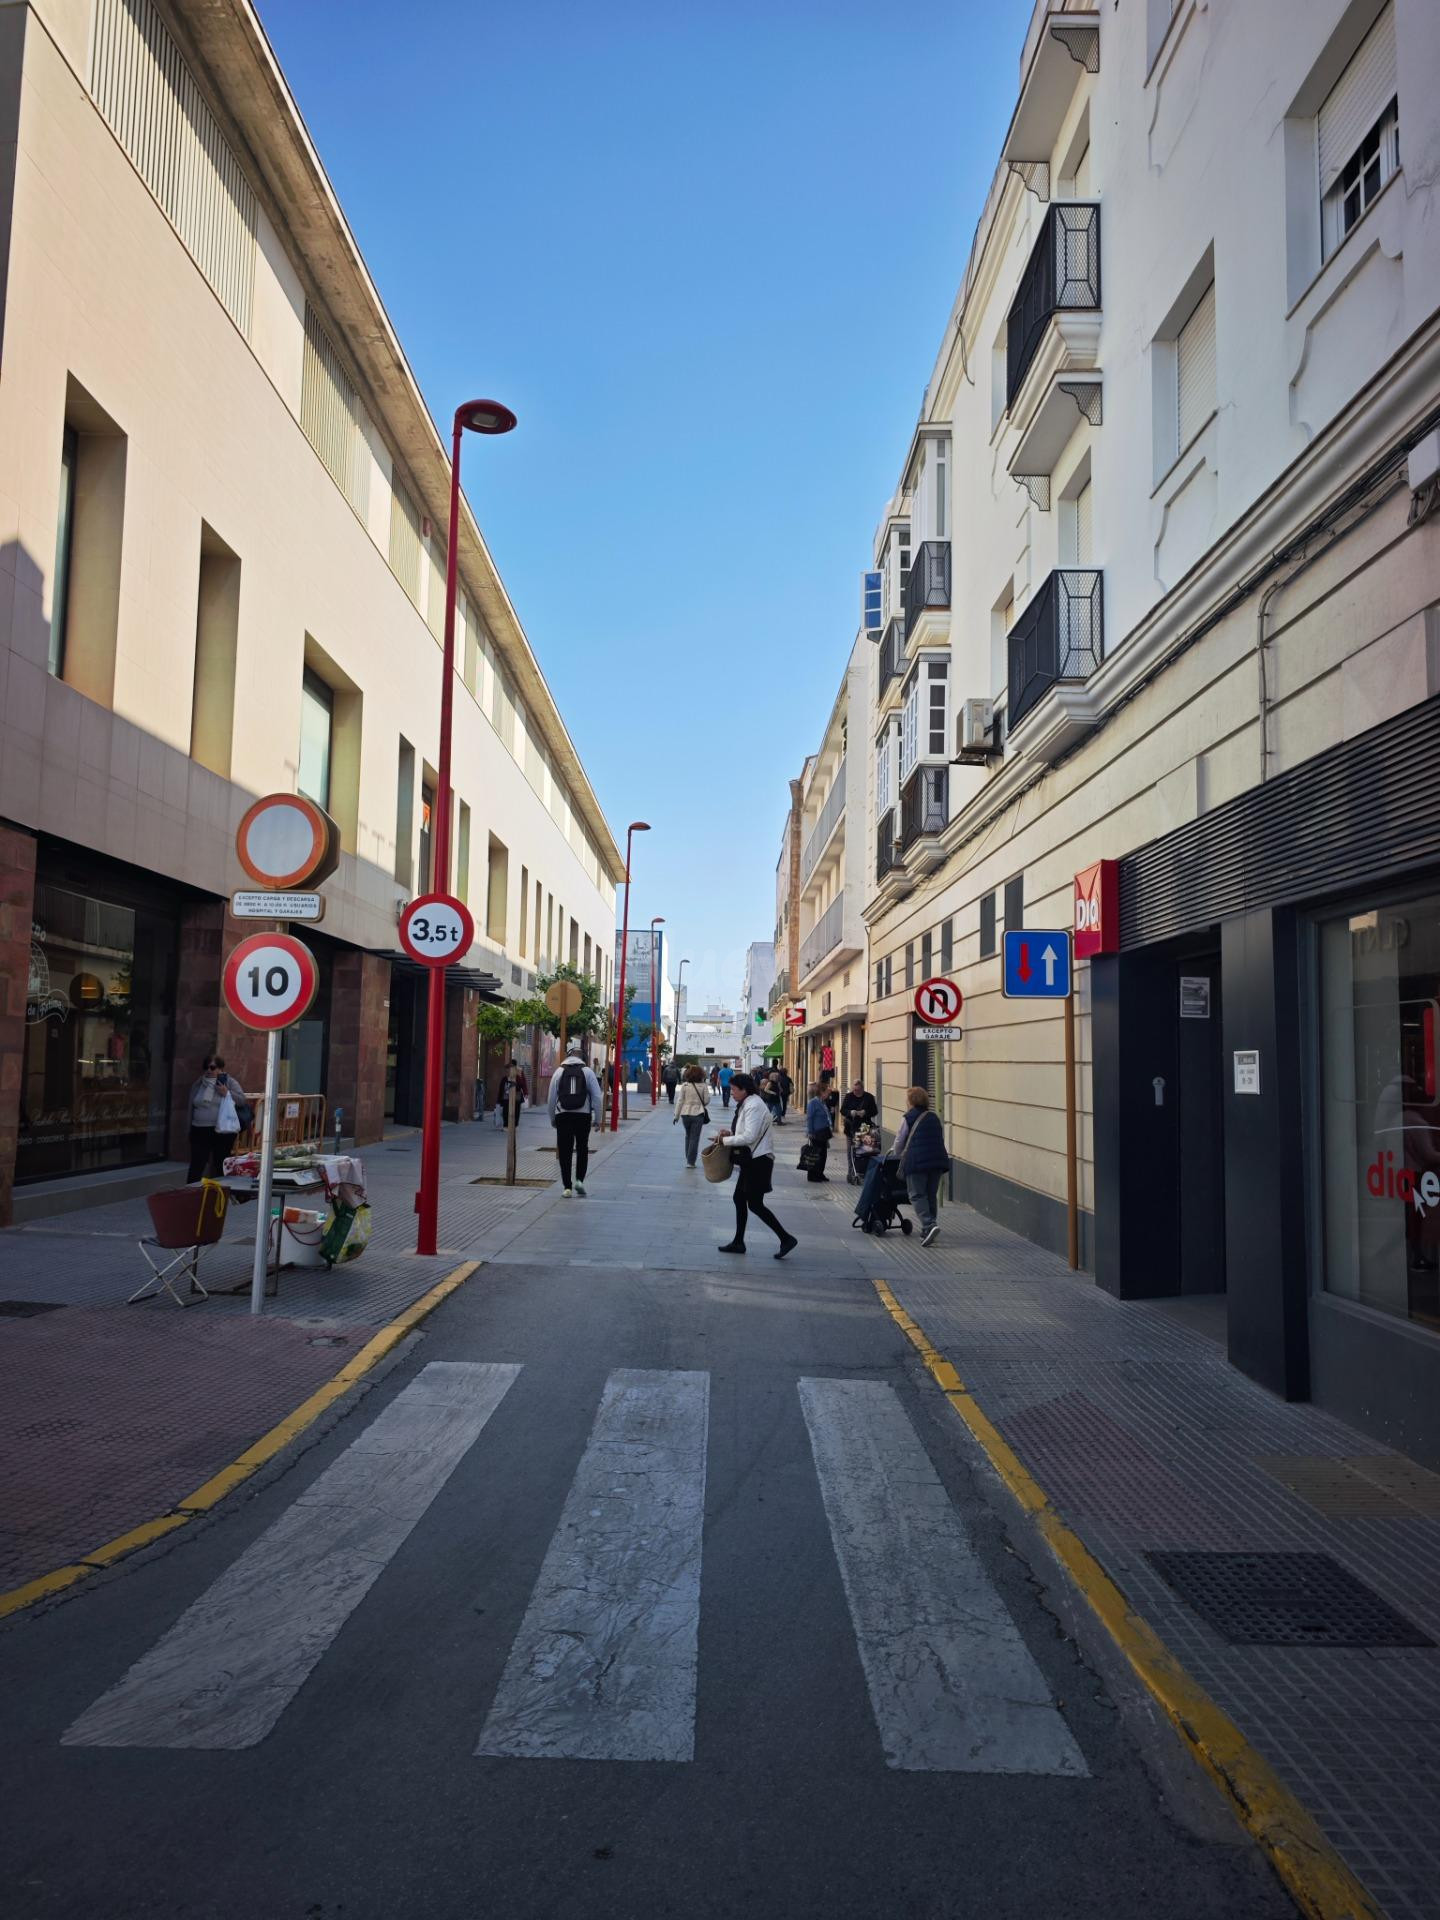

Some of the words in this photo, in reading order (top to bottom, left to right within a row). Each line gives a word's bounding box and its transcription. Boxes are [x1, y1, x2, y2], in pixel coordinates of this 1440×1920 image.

[412, 918, 447, 943] 3,5
[450, 926, 458, 942] t
[248, 966, 289, 998] 10
